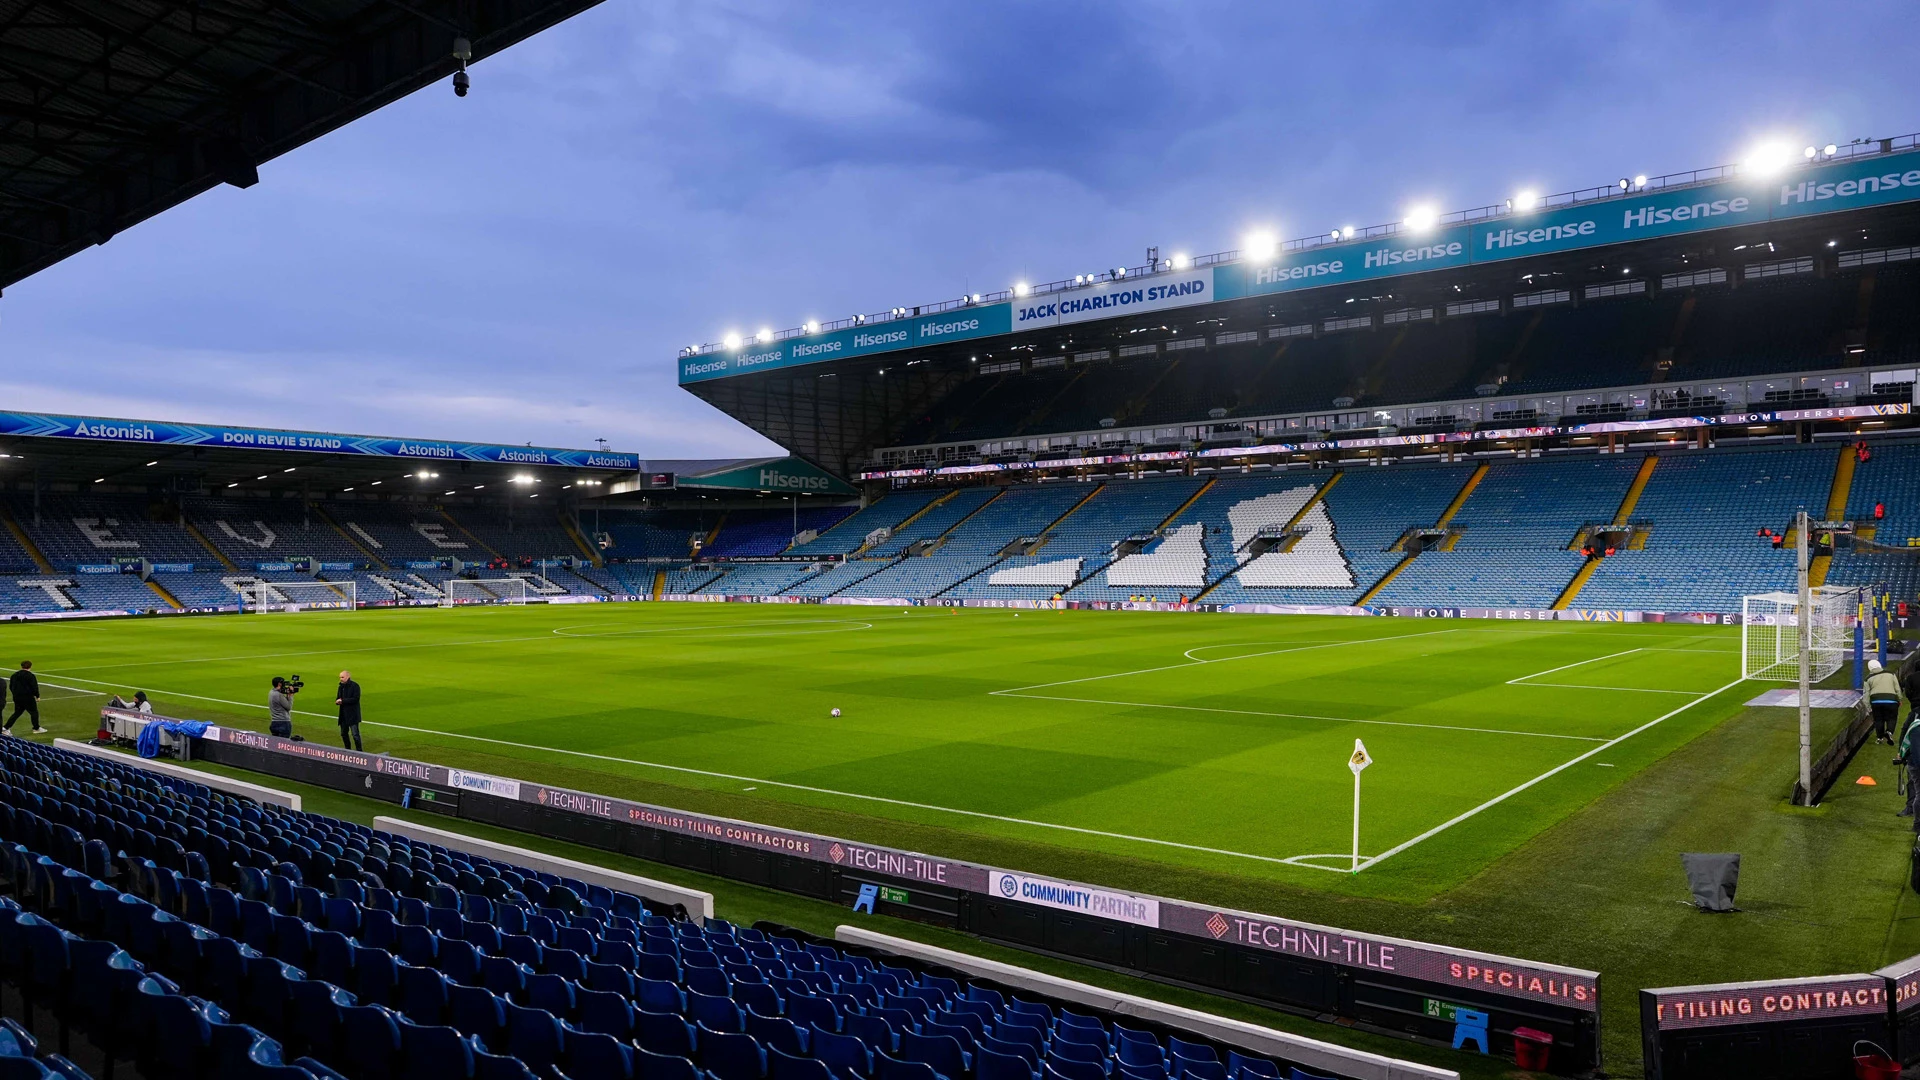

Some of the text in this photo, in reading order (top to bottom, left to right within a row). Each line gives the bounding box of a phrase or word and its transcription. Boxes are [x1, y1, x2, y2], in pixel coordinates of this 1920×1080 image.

[1780, 169, 1920, 206] Hisense
[1623, 196, 1748, 229] Hisense
[1485, 220, 1595, 250] Hisense
[1364, 241, 1462, 269] Hisense
[1256, 260, 1343, 285] Hisense
[1019, 279, 1205, 322] JACK CHARLTON STAND
[920, 318, 979, 338] Hisense
[792, 339, 842, 358] Hisense
[853, 329, 907, 348] Hisense
[684, 359, 727, 376] Hisense
[736, 349, 782, 367] Hisense
[1738, 412, 1781, 422] HOME
[1794, 407, 1857, 418] JERSEY
[74, 420, 154, 440] Astonish
[1465, 426, 1586, 439] LEEDS UNITED
[223, 431, 341, 450] DON REVIE STAND
[398, 441, 454, 458] Astonish
[1312, 441, 1341, 449] HOME
[1350, 438, 1391, 446] JERSEY
[498, 448, 548, 463] Astonish
[587, 454, 631, 467] Astonish
[759, 469, 829, 490] Hisense
[80, 565, 117, 573] Astonish
[936, 599, 968, 607] HOME
[976, 600, 1021, 608] JERSEY
[1100, 602, 1236, 613] LEEDS UNITED
[1346, 607, 1559, 620] 24/25 HOME JERSE
[235, 732, 269, 749] TECHNI-TILE
[277, 742, 306, 755] SPECIALIST
[307, 747, 325, 758] TILING
[326, 750, 368, 766] CONTRACTORS
[384, 760, 431, 780] TECHNI-TILE
[462, 775, 515, 796] COMMUNITY PARTNER
[549, 791, 810, 853] TECHNI-TILE SPECIALIST TILING CONTRACTORS
[847, 847, 947, 882] TECHNI-TILE
[1022, 881, 1147, 921] COMMUNITY PARTNER
[1234, 918, 1395, 970] TECHNI-TILE
[1675, 998, 1751, 1020] TILING
